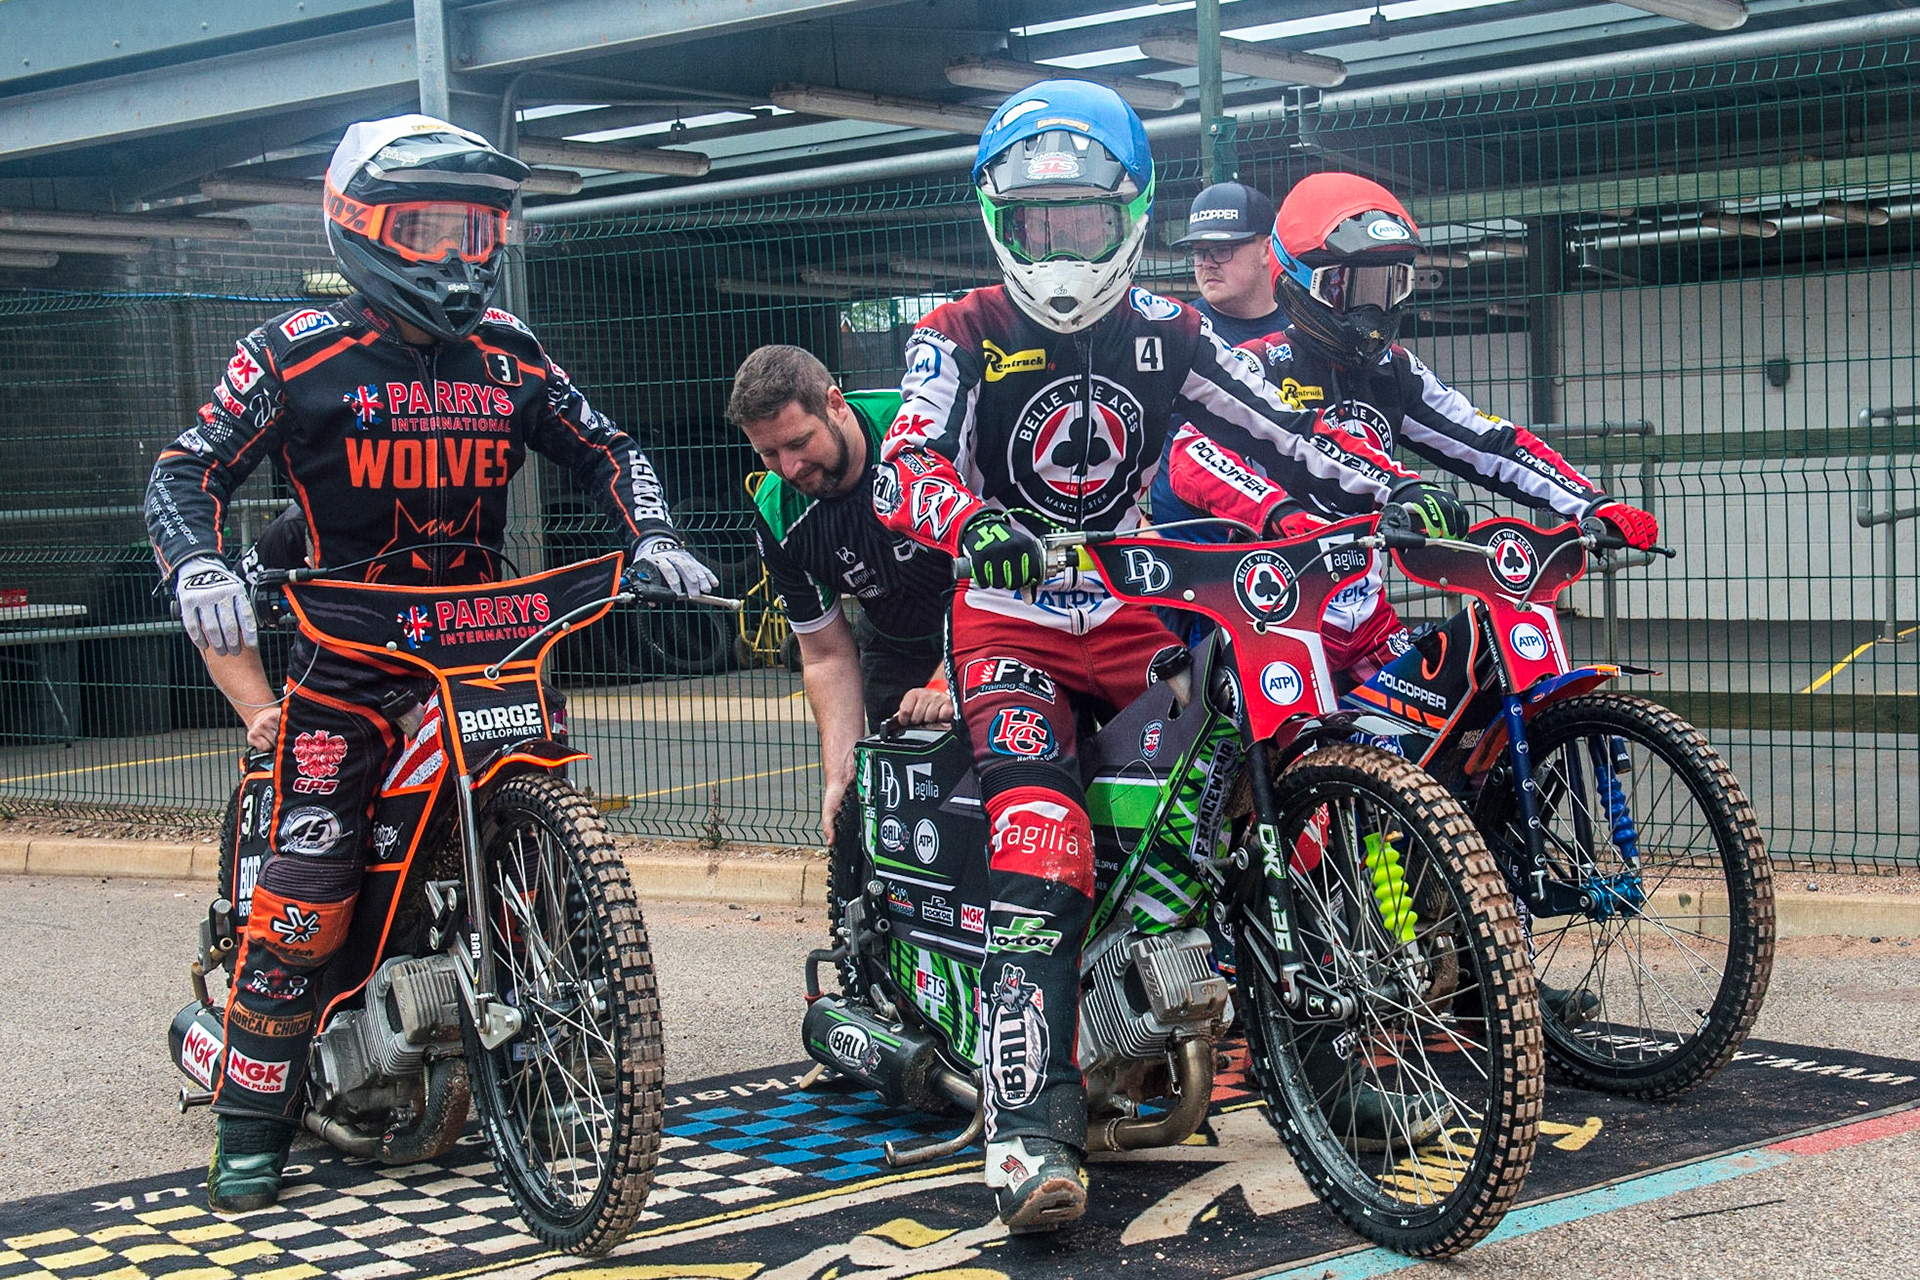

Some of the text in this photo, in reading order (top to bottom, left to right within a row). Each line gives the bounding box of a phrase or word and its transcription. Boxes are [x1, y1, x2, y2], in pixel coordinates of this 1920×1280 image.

[1031, 159, 1074, 172] STS
[289, 314, 329, 335] 100%
[984, 353, 1044, 372] Rentruck
[1140, 337, 1159, 370] 4
[497, 354, 512, 383] 3
[386, 380, 515, 417] PARRYS
[391, 416, 512, 433] INTERNATIONAL
[1018, 384, 1138, 442] BELLE VE ACES
[1371, 418, 1392, 450] ACES
[345, 437, 512, 489] WOLVES
[1502, 531, 1516, 540] VUE
[1119, 546, 1173, 596] DD
[1237, 554, 1293, 584] BELLE VUE ACES
[1333, 547, 1367, 575] agilia
[435, 592, 551, 632] PARRYS
[1518, 635, 1542, 648] ATPI
[980, 682, 1016, 692] Training
[993, 659, 1055, 695] FTS
[1269, 674, 1295, 691] ATPI
[1377, 669, 1447, 711] POLCOPPER
[458, 702, 542, 734] BORGE
[462, 724, 543, 744] DEVELOPMENT
[293, 777, 341, 795] GPS
[914, 779, 940, 801] agilia
[241, 794, 255, 836] 3
[290, 817, 333, 842] 45
[917, 834, 934, 849] ATPI
[1006, 823, 1079, 857] agilia
[1257, 823, 1287, 879] CWR
[961, 906, 985, 926] NGK
[469, 932, 482, 959] BAR
[925, 973, 946, 997] FTS
[230, 1007, 269, 1035] NORCAL
[184, 1027, 218, 1074] NGK
[229, 1070, 282, 1092] SPARK PLUGS
[230, 1051, 287, 1083] NGK
